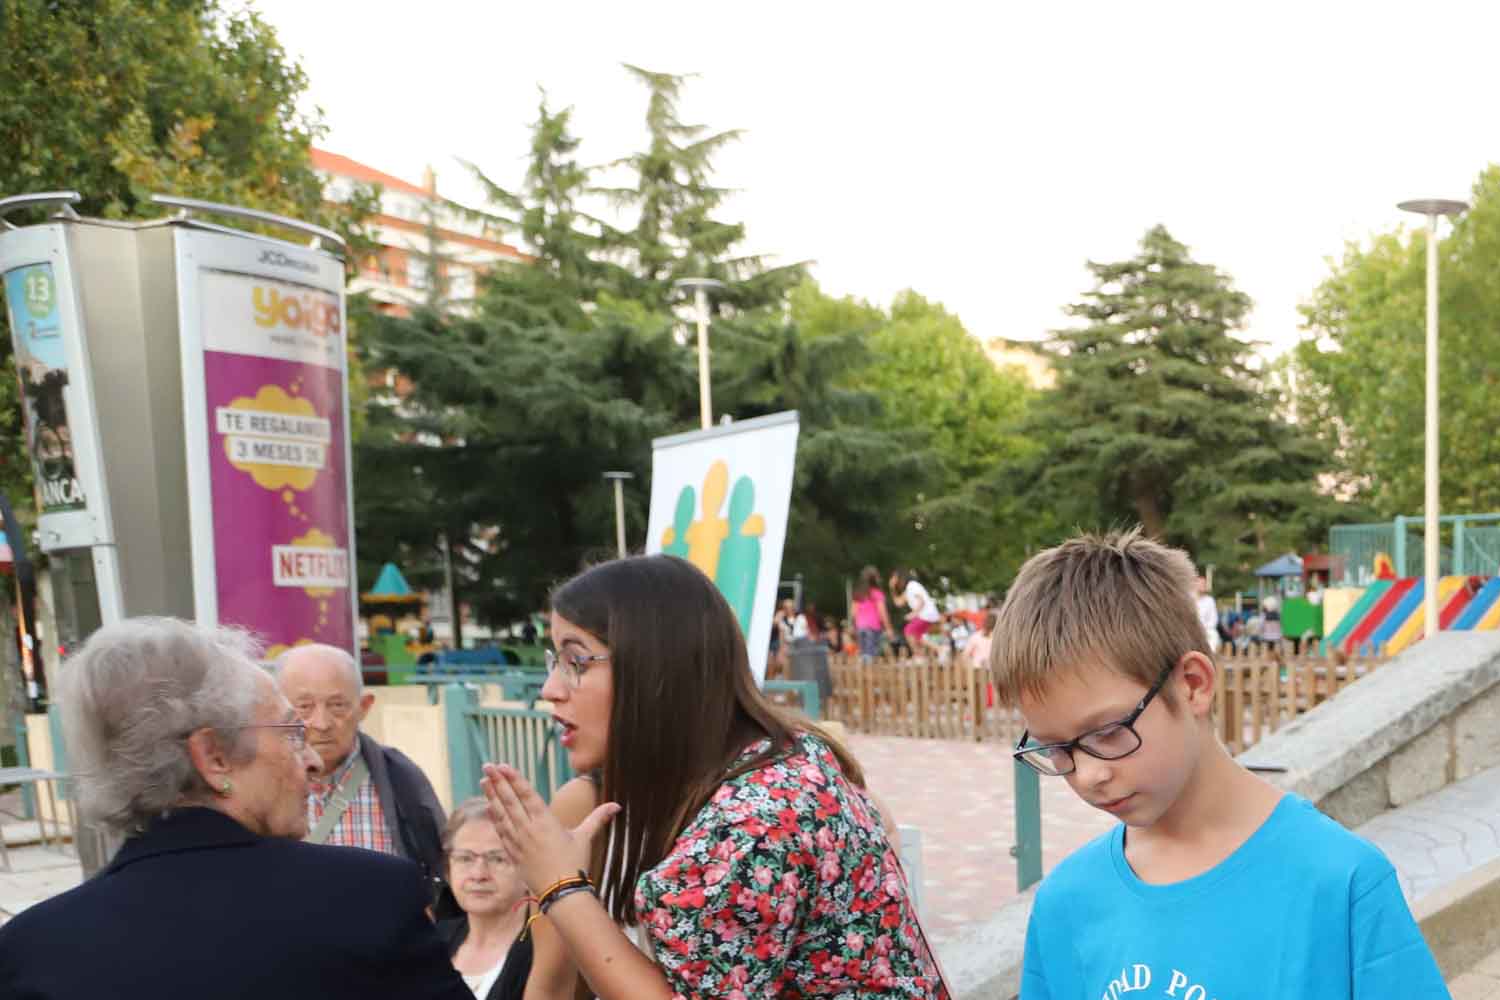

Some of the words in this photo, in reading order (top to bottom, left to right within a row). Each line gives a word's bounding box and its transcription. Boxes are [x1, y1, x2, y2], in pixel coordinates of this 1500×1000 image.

[224, 413, 243, 430] TE
[237, 440, 246, 457] 3
[253, 443, 302, 463] MESES
